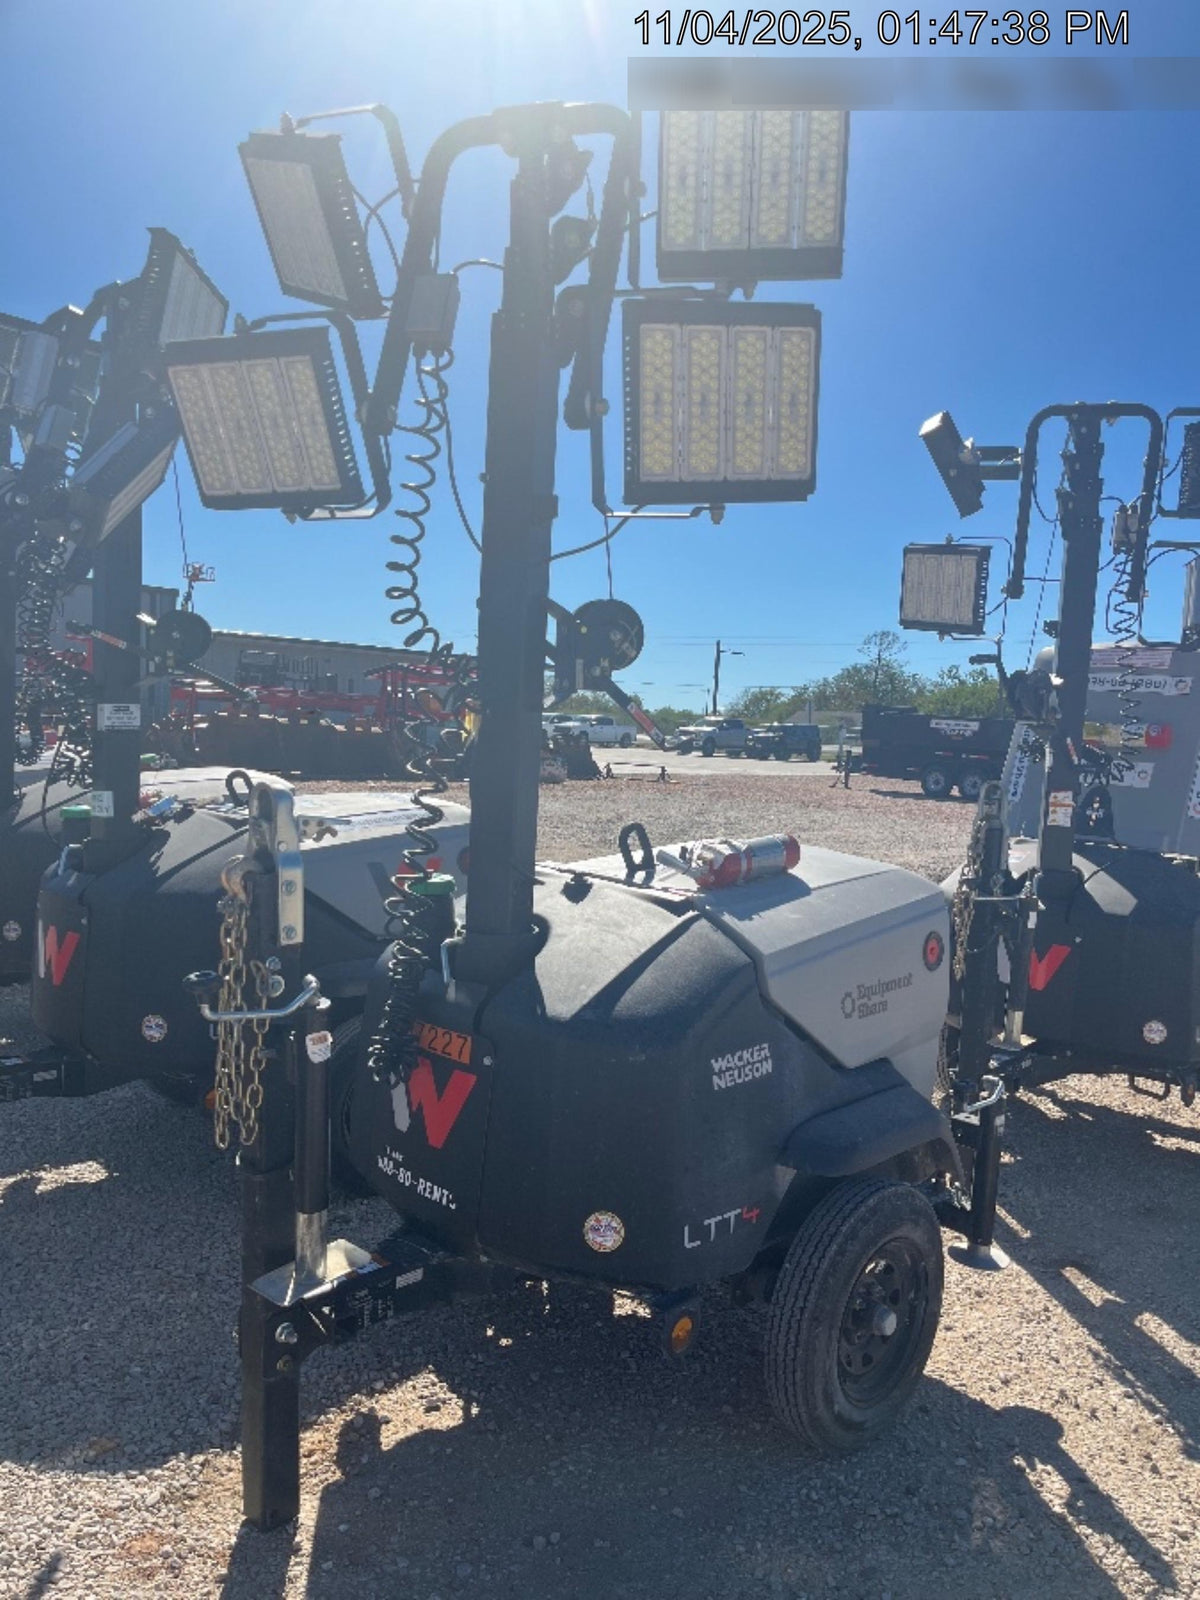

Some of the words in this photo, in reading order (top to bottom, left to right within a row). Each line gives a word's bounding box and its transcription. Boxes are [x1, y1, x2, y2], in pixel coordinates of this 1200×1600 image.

[856, 972, 913, 1001] Equipment
[857, 999, 889, 1019] Share
[710, 1043, 771, 1073] WACKER
[712, 1059, 773, 1090] NEUSON
[684, 1206, 760, 1249] LTT4
